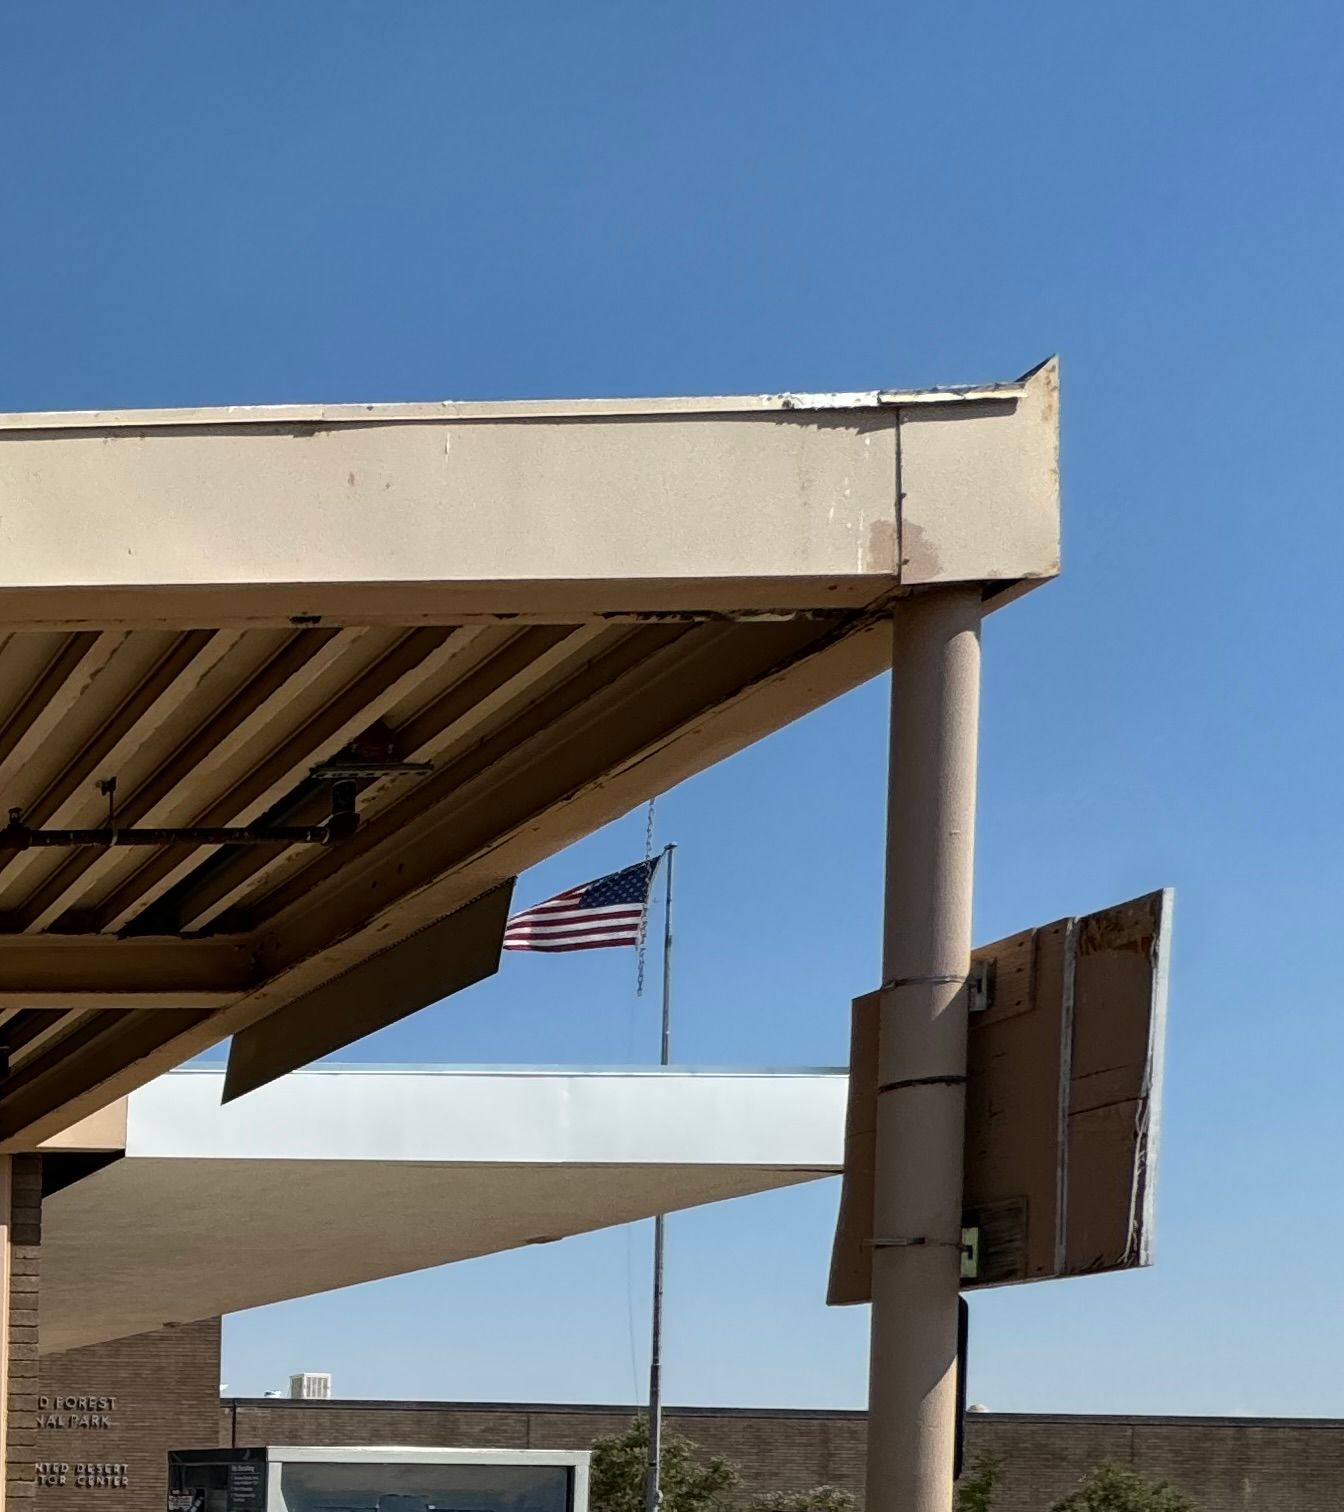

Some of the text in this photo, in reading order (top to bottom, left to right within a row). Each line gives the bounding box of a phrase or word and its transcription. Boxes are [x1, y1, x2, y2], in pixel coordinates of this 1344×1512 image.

[56, 1396, 117, 1410] FOREST
[71, 1414, 113, 1427] PARK
[34, 1462, 129, 1475] NTED DESERT
[77, 1475, 129, 1487] CENTER
